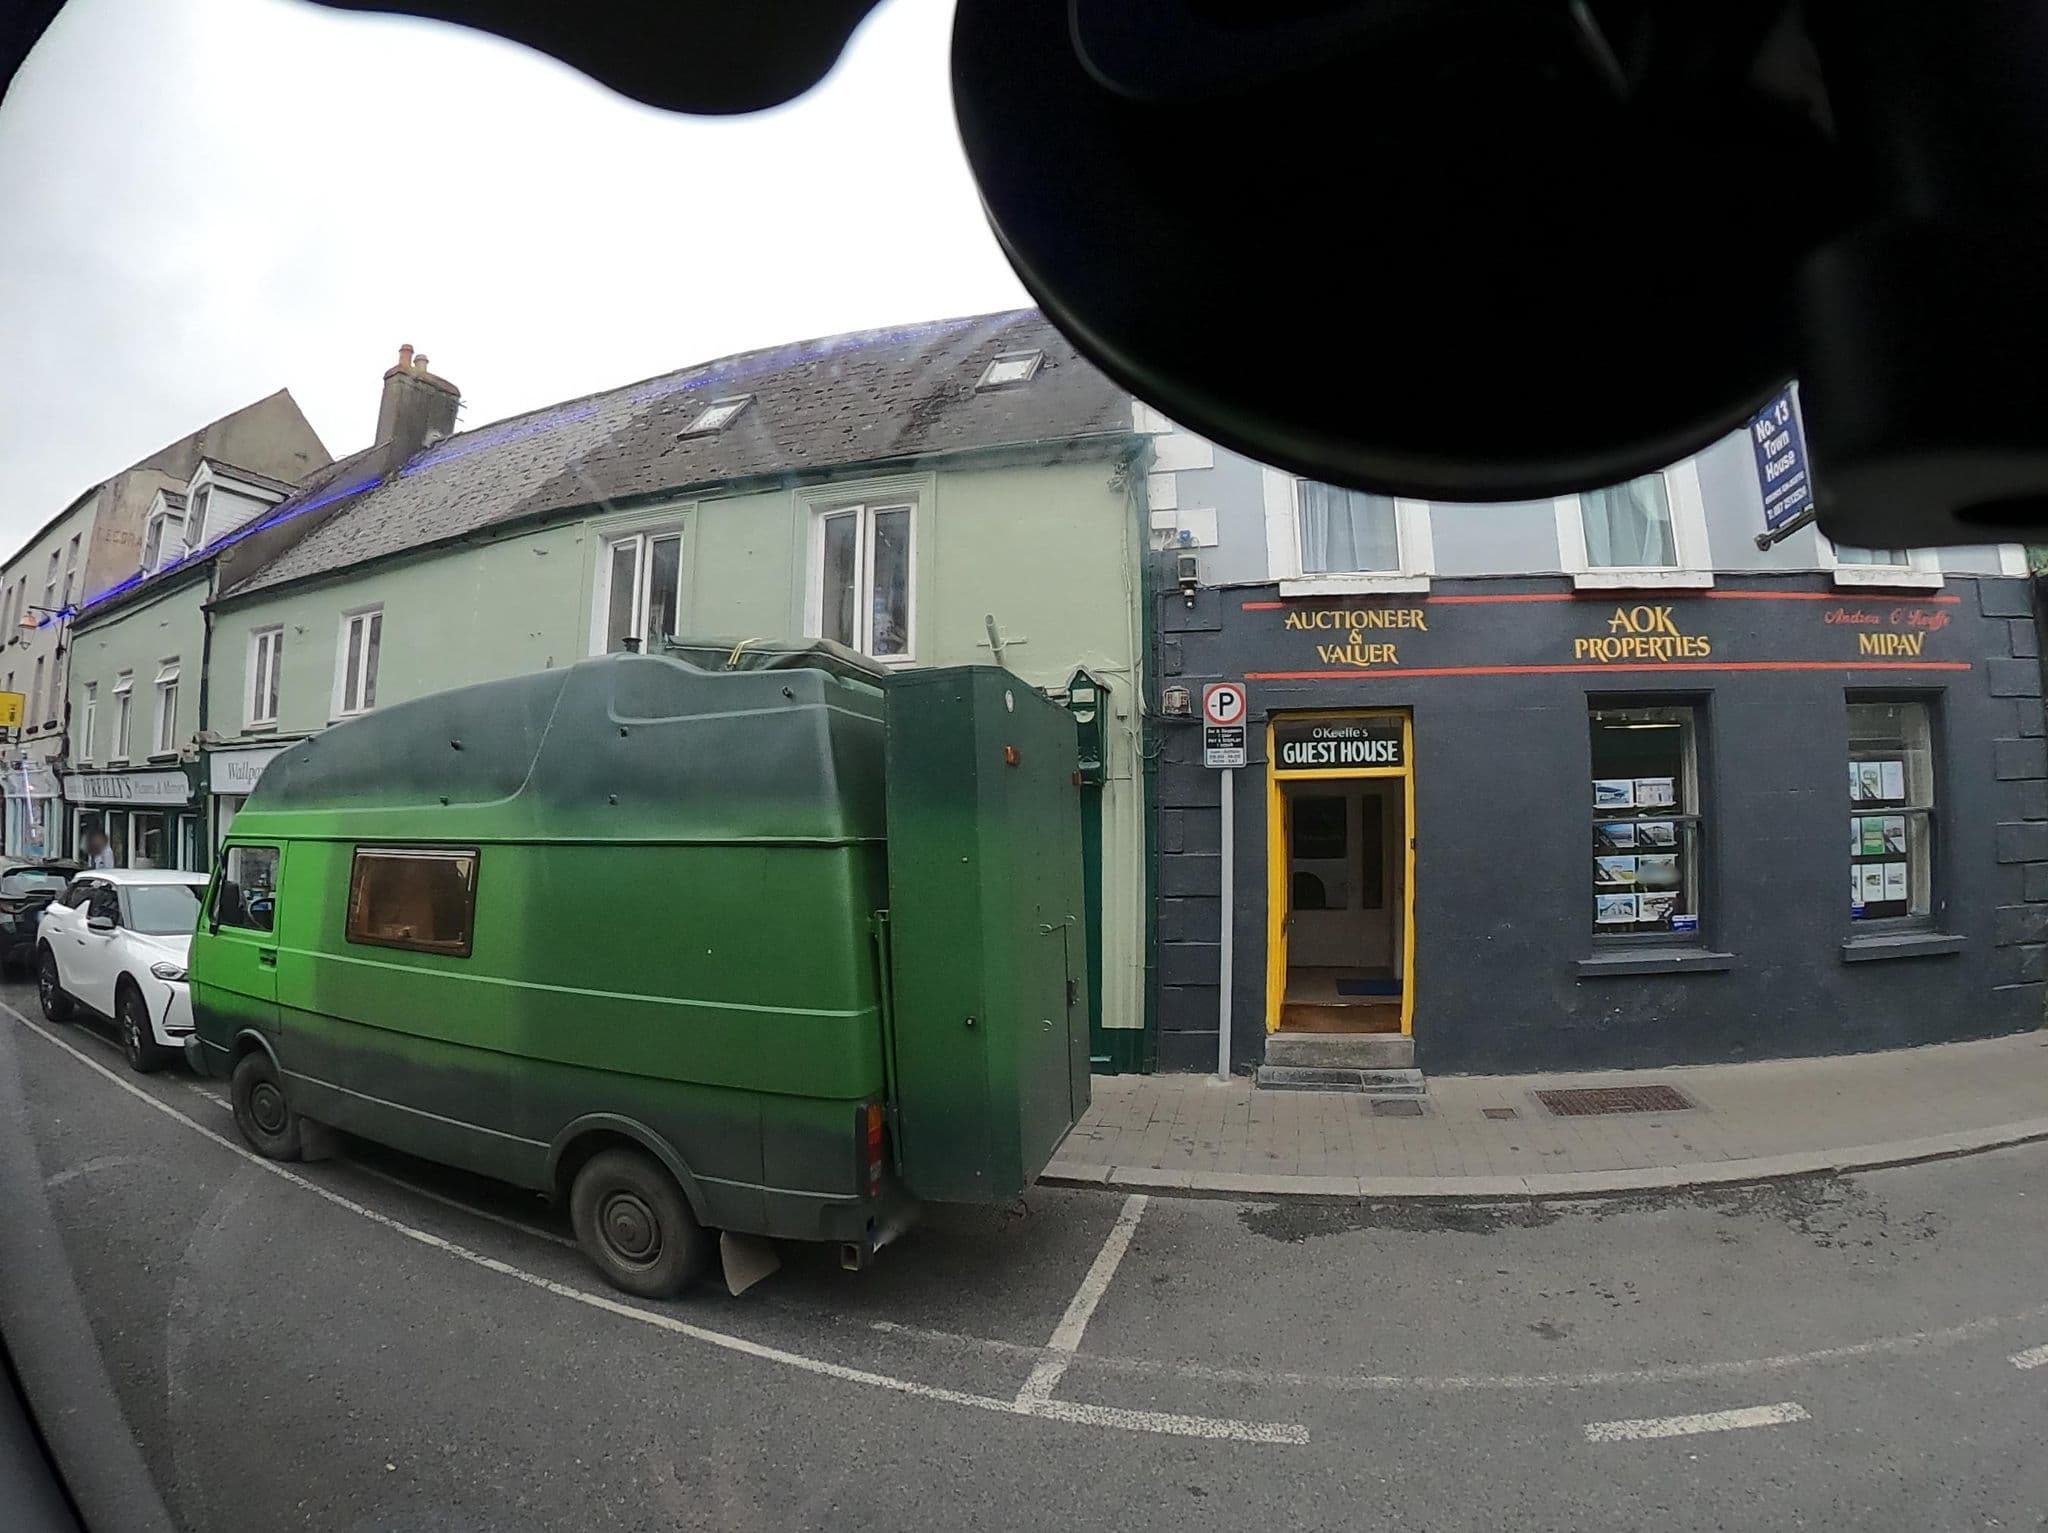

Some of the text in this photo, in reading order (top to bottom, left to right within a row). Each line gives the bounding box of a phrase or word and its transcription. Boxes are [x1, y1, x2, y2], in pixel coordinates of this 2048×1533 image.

[1756, 400, 1789, 443] No. 13
[1763, 430, 1790, 459] Town
[1765, 450, 1796, 482] House
[1284, 609, 1428, 632] AUCTIONEER
[1607, 605, 1681, 637] AOK
[1349, 628, 1363, 644] &
[1858, 631, 1926, 656] MIPAV
[1316, 643, 1399, 667] VALUER
[1574, 635, 1712, 663] PROPERTIES
[1219, 692, 1235, 716] P
[1283, 740, 1399, 763] GUEST HOUSE
